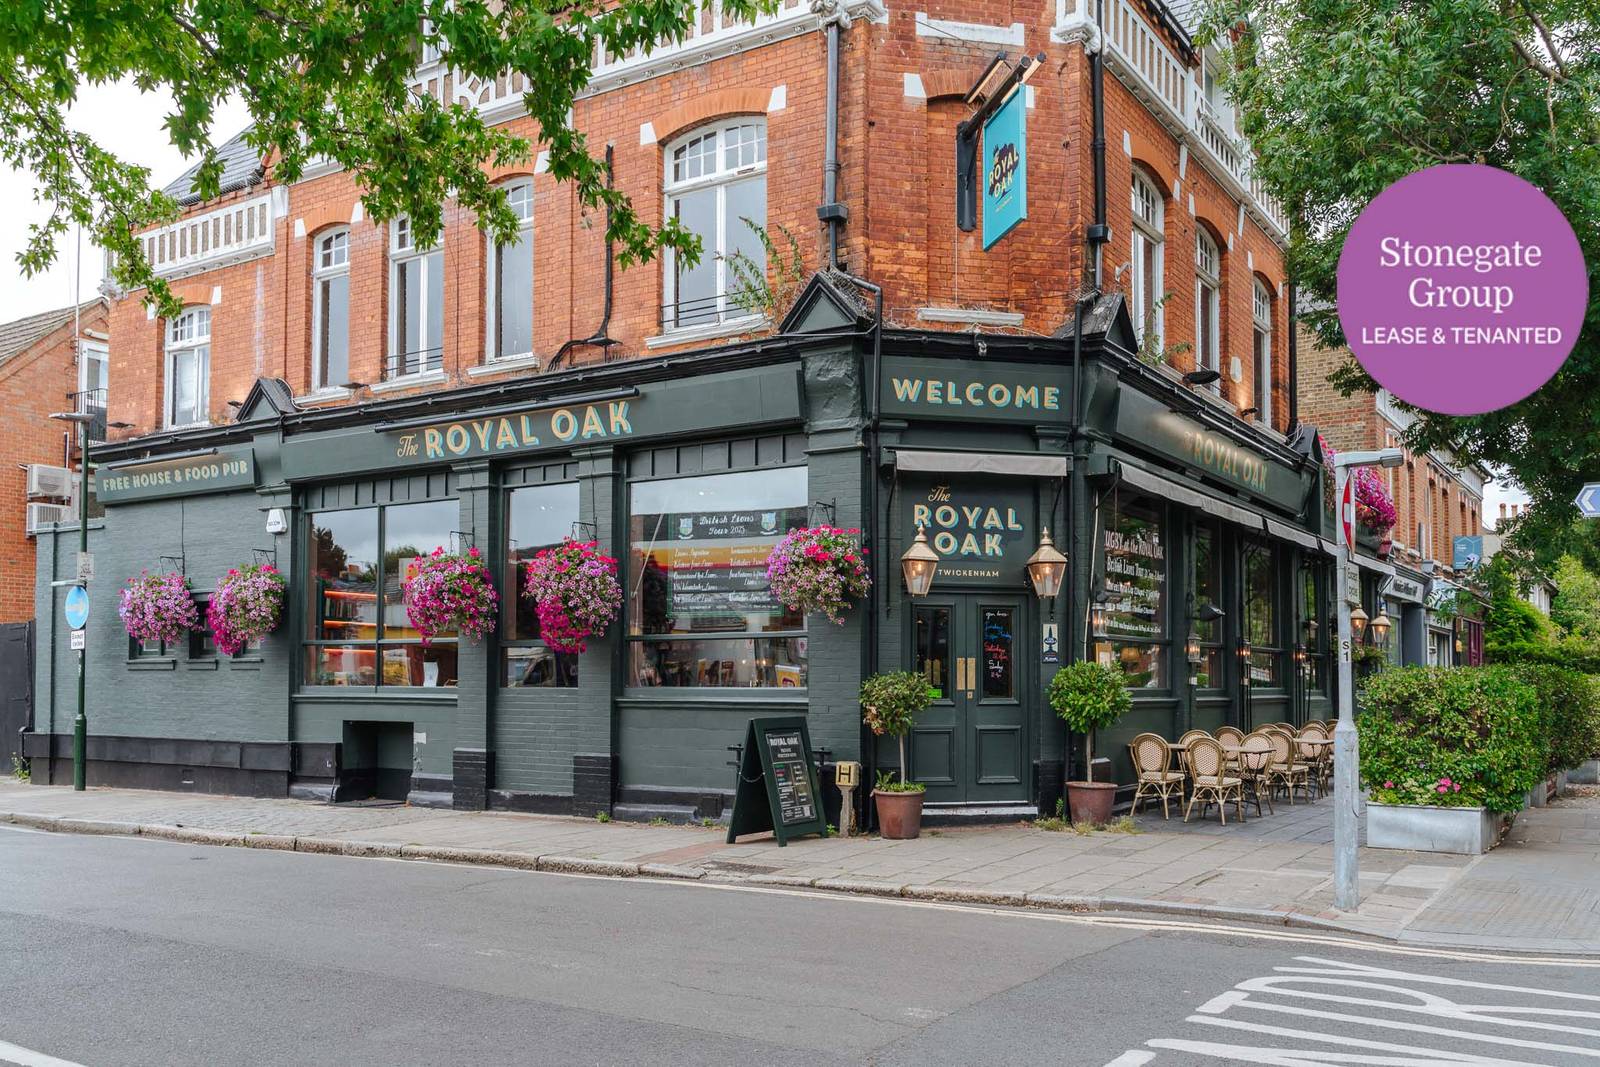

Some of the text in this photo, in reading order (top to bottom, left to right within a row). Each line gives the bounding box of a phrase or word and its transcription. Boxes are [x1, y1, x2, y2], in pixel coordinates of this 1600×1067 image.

[988, 147, 1019, 186] ROYAL
[993, 172, 1013, 198] OAK
[892, 378, 1059, 410] WELCOME
[397, 400, 633, 459] The ROYAL OAK
[1194, 433, 1238, 479] ROYAL
[1243, 457, 1267, 492] OAK
[103, 460, 248, 492] FREE HOUSE & FOOD PUB
[928, 485, 951, 502] The
[914, 504, 1023, 531] ROYAL
[934, 531, 1003, 556] OAK
[938, 569, 999, 577] TWICKENHAM
[1342, 641, 1350, 650] S
[838, 765, 851, 783] H
